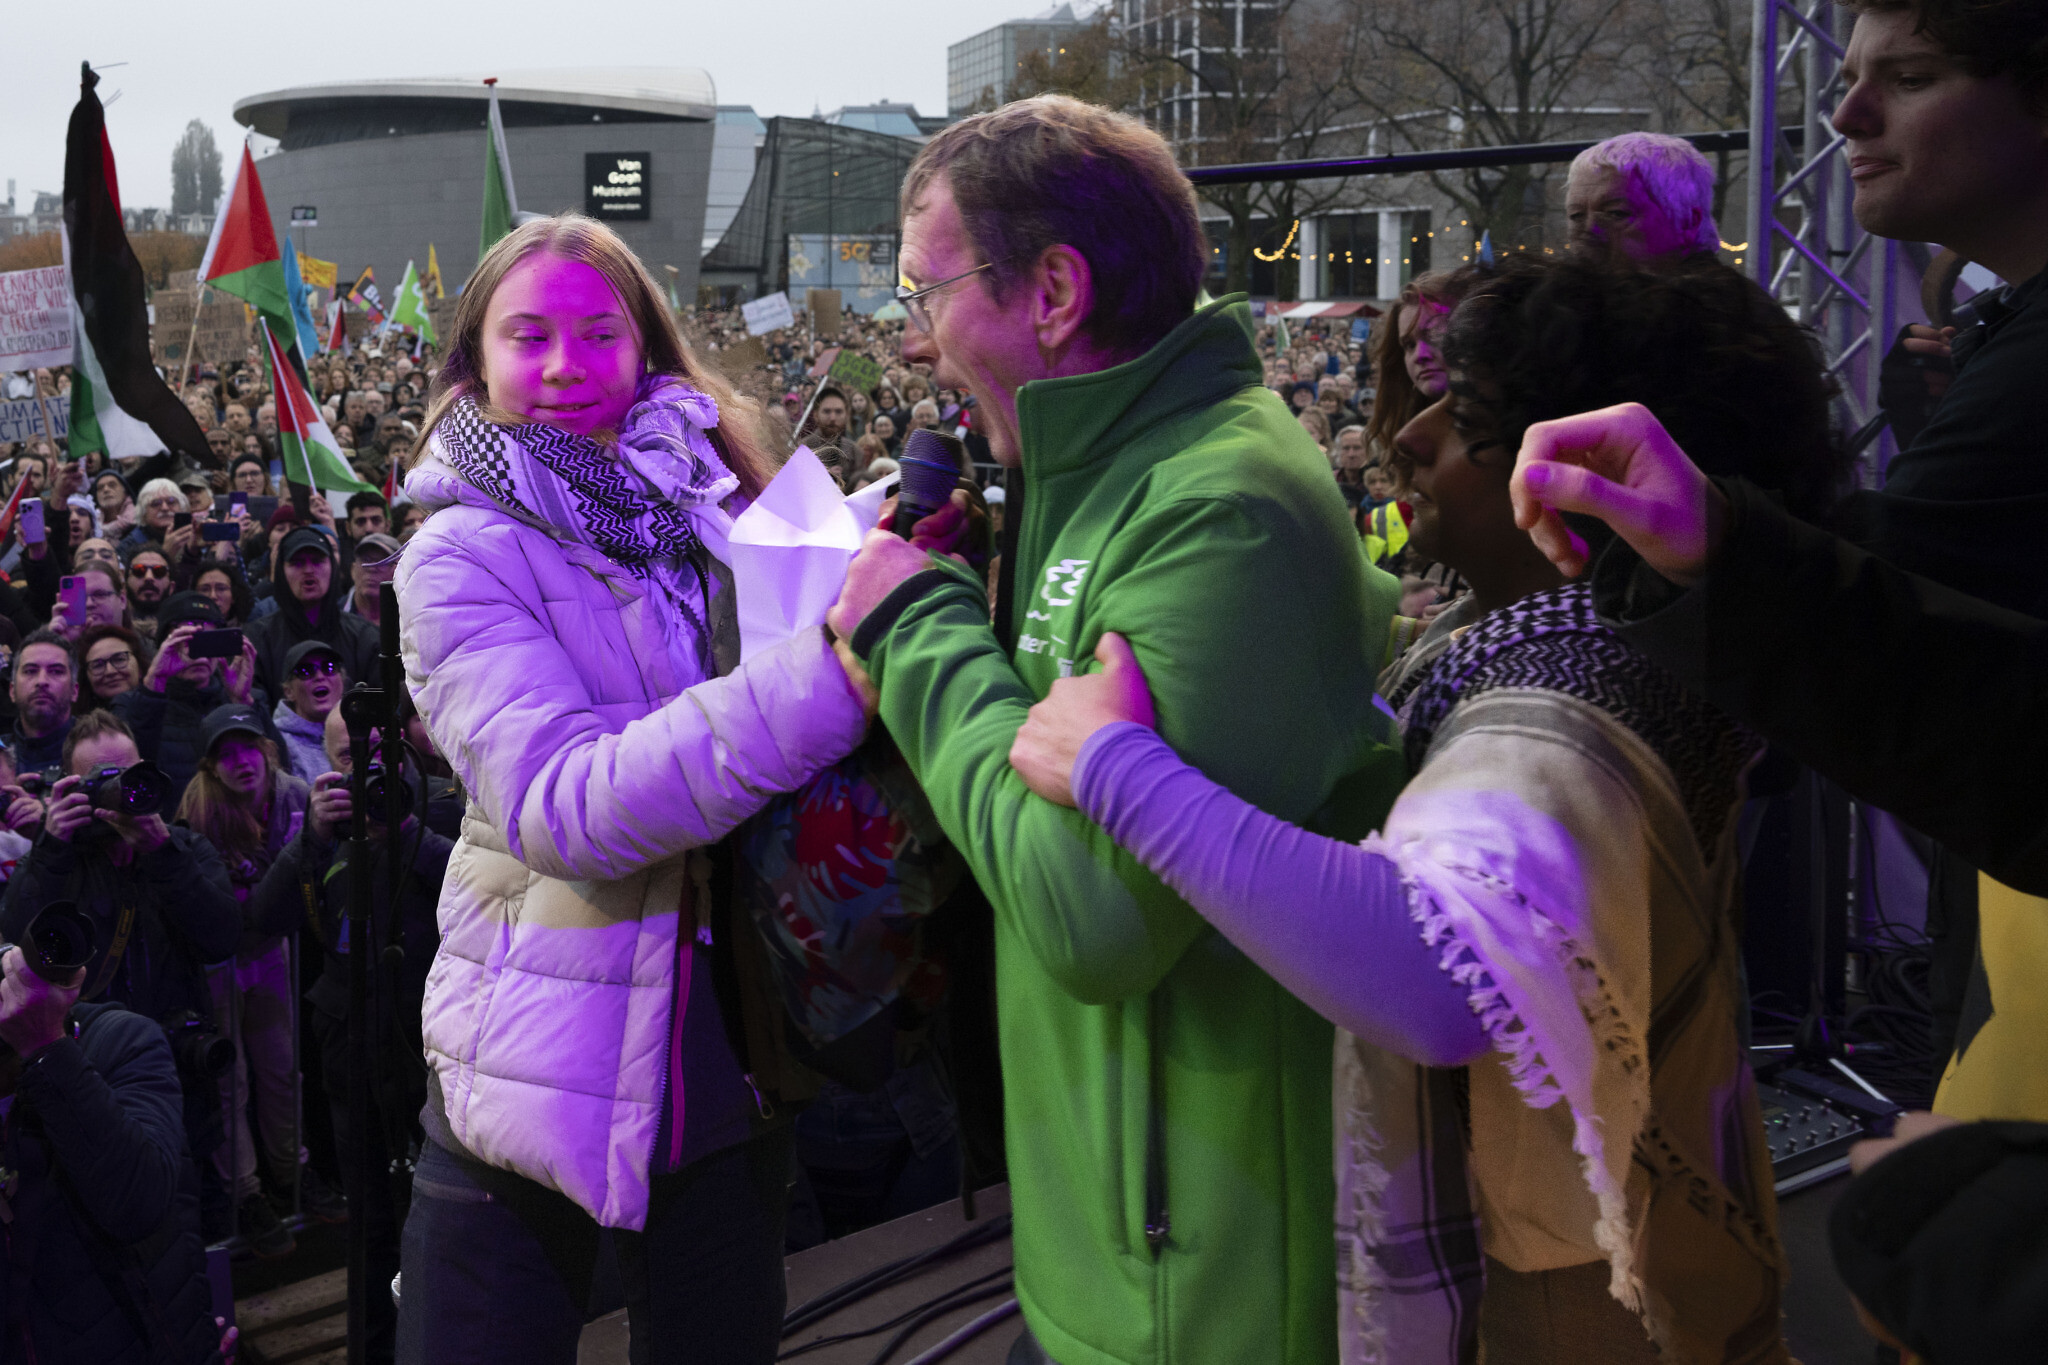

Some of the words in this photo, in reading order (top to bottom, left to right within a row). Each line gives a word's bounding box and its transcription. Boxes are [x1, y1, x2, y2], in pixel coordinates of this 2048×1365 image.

[616, 159, 642, 171] Van
[607, 171, 642, 186] Gogh
[592, 185, 642, 197] Museum
[0, 396, 71, 420] IMAAT-
[0, 417, 47, 442] CTIE
